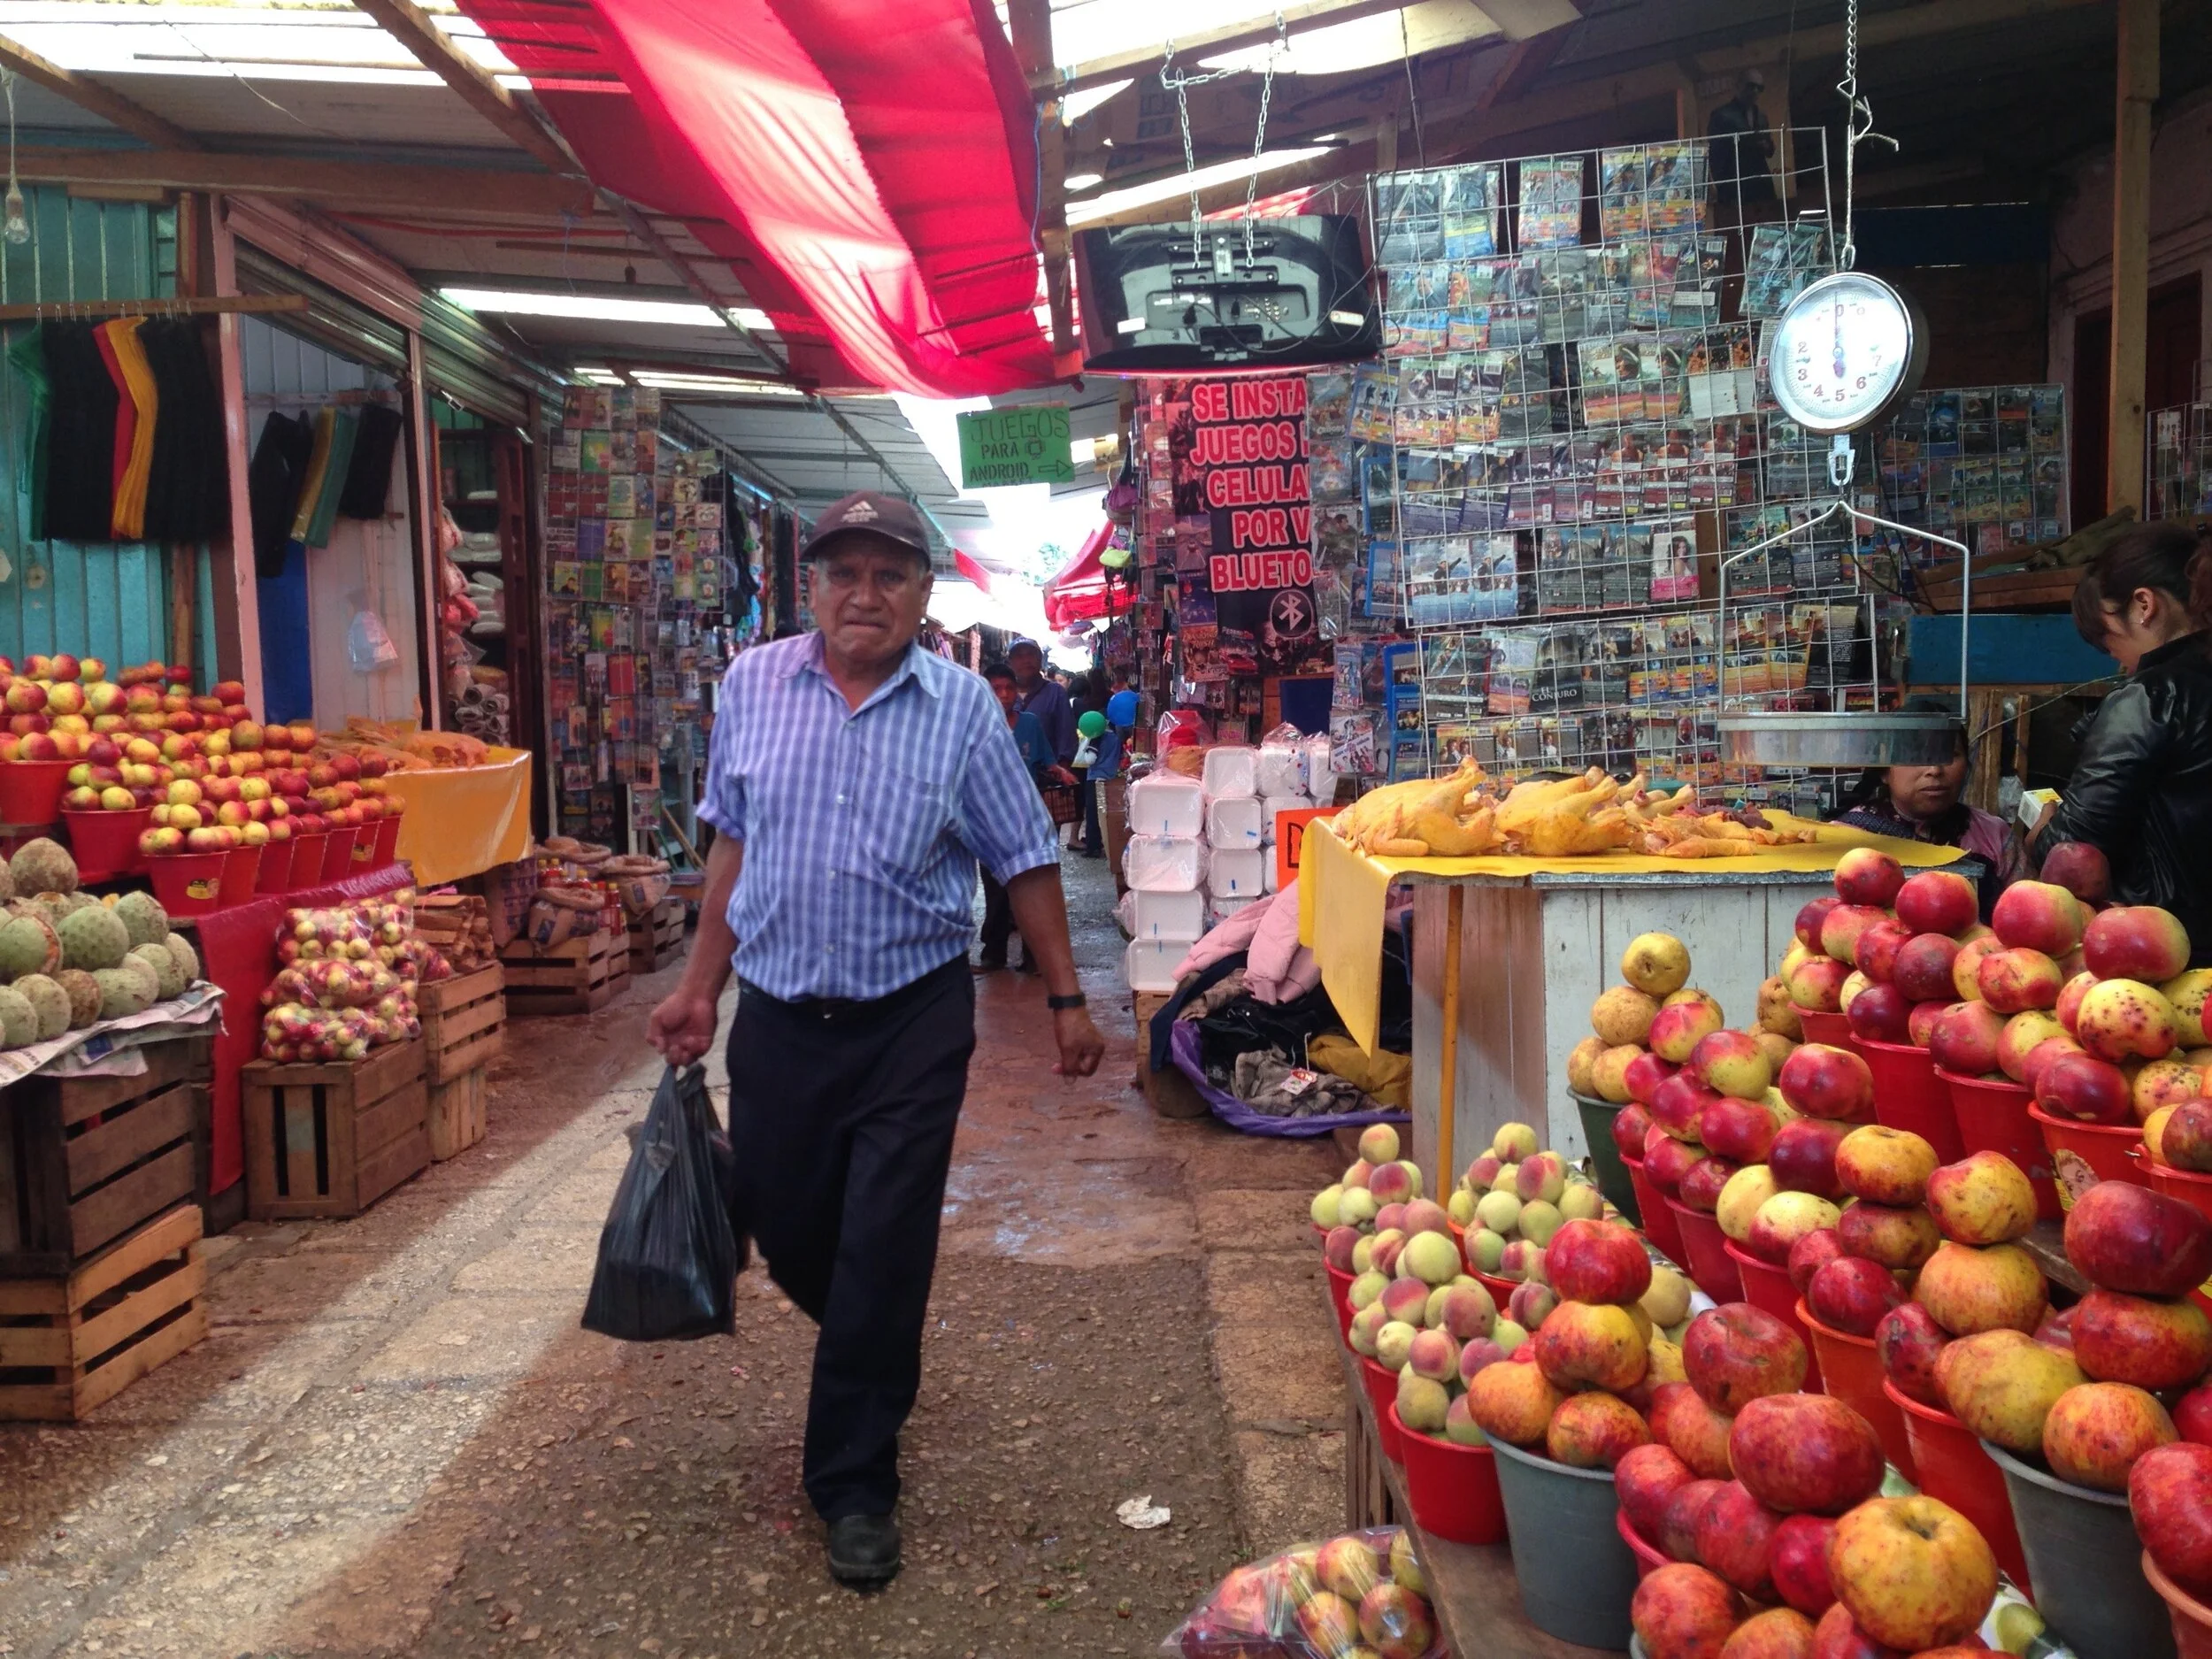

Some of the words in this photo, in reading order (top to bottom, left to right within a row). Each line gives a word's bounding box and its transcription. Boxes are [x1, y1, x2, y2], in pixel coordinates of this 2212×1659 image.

[1798, 342, 1809, 354] 2
[1798, 368, 1808, 380] 3
[1856, 376, 1867, 389] 6
[1192, 383, 1228, 422] SE
[1231, 378, 1307, 417] INSTA
[1814, 384, 1824, 397] 4
[1835, 388, 1845, 402] 5
[971, 409, 1070, 442] JUEGOS
[981, 442, 1019, 459] PARA
[1189, 422, 1296, 465] JUEGOS
[970, 462, 1029, 482] ANDROID
[1207, 464, 1310, 507] CELULA
[1232, 509, 1289, 549] POR
[1210, 549, 1312, 593] BLUETO
